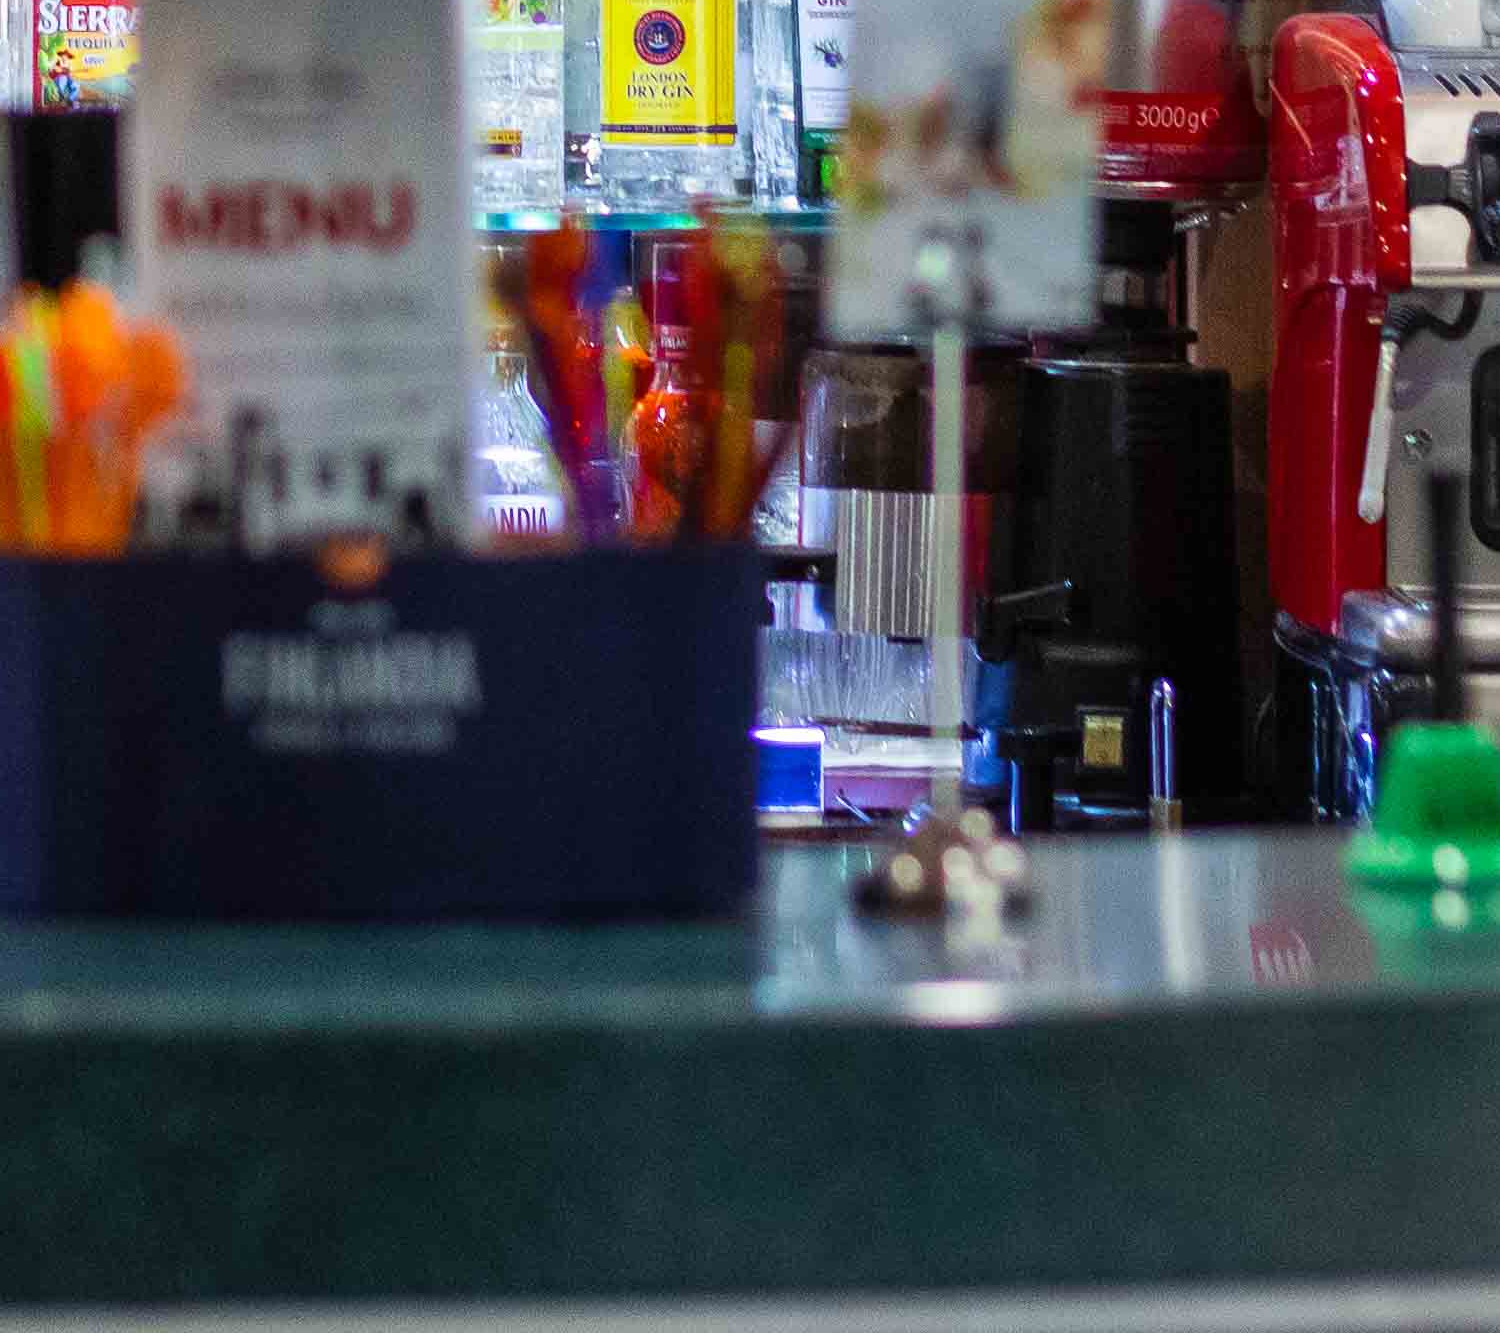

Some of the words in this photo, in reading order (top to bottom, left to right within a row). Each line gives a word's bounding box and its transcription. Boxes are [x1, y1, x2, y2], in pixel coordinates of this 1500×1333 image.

[631, 71, 688, 84] LONDON
[627, 84, 660, 100] DRY
[662, 84, 696, 101] GIN
[158, 181, 417, 254] MENU
[487, 506, 550, 534] ANDIA
